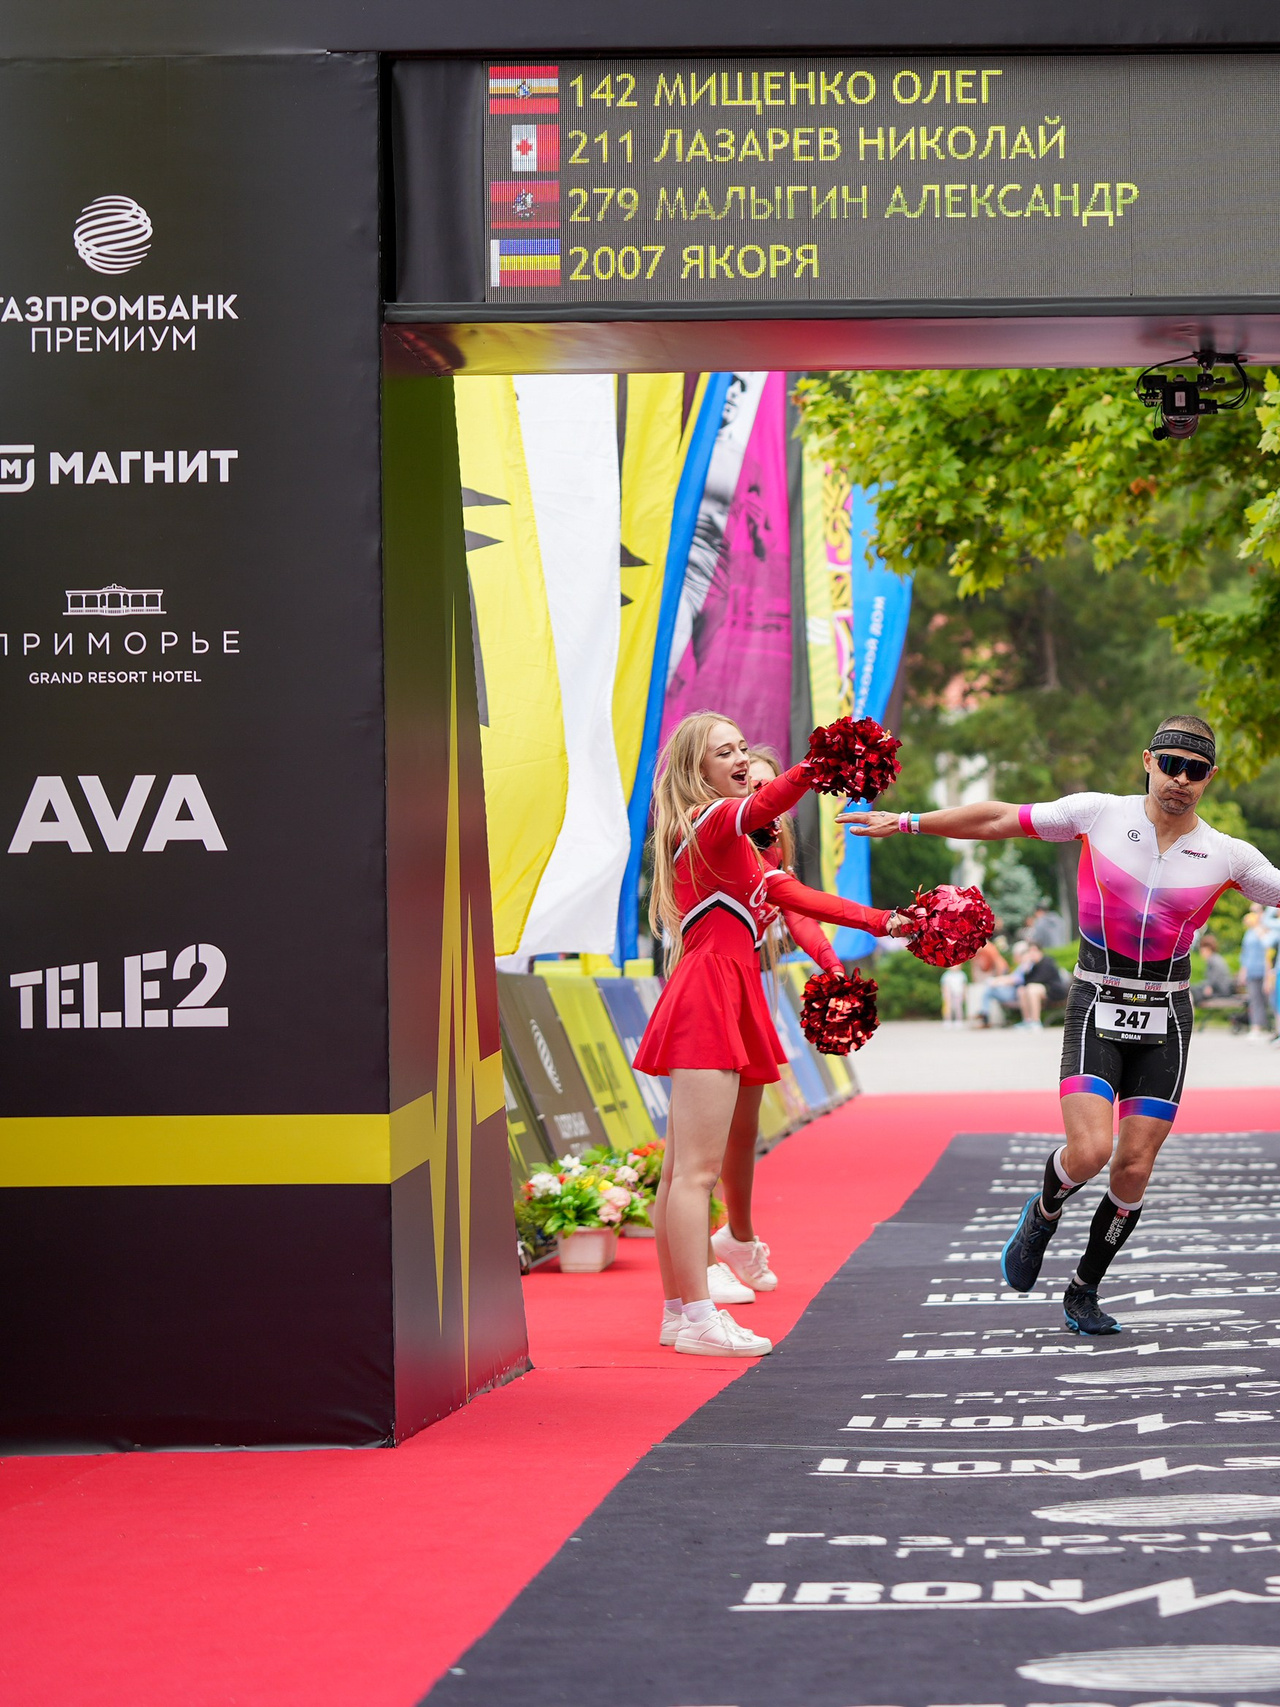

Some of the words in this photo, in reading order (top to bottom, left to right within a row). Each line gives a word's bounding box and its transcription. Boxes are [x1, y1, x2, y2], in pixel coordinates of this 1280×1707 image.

[571, 72, 637, 108] 142
[655, 71, 875, 115] МИЩЕНКО
[893, 70, 1003, 104] ОЛЕГ
[569, 130, 633, 164] 211
[654, 127, 841, 163] ЛАЗАРЕВ
[859, 117, 1066, 160] НИКОЛАЙ
[569, 187, 639, 223] 279
[656, 186, 868, 221] МАЛЫГИН
[885, 182, 1140, 226] АЛЕКСАНДР
[570, 245, 664, 281] 2007
[682, 244, 819, 280] ЯКОРЯ
[0, 295, 238, 323] АЗПРОМБАНК
[31, 326, 196, 353] ПРЕМИУМ
[50, 450, 238, 484] МАГНИТ
[29, 672, 83, 685] GRAND
[88, 671, 148, 684] RESORT
[152, 671, 202, 682] HOTEL
[8, 775, 228, 853] AVA
[10, 943, 229, 1029] TELE2
[1115, 1009, 1150, 1029] 247
[1121, 1033, 1141, 1041] ROMAN
[1110, 1225, 1124, 1245] SPORT
[926, 1292, 1065, 1304] IRO
[895, 1345, 1094, 1360] IRON
[847, 1414, 1085, 1429] IRON
[817, 1457, 1081, 1474] IRON
[742, 1578, 1084, 1604] IRON
